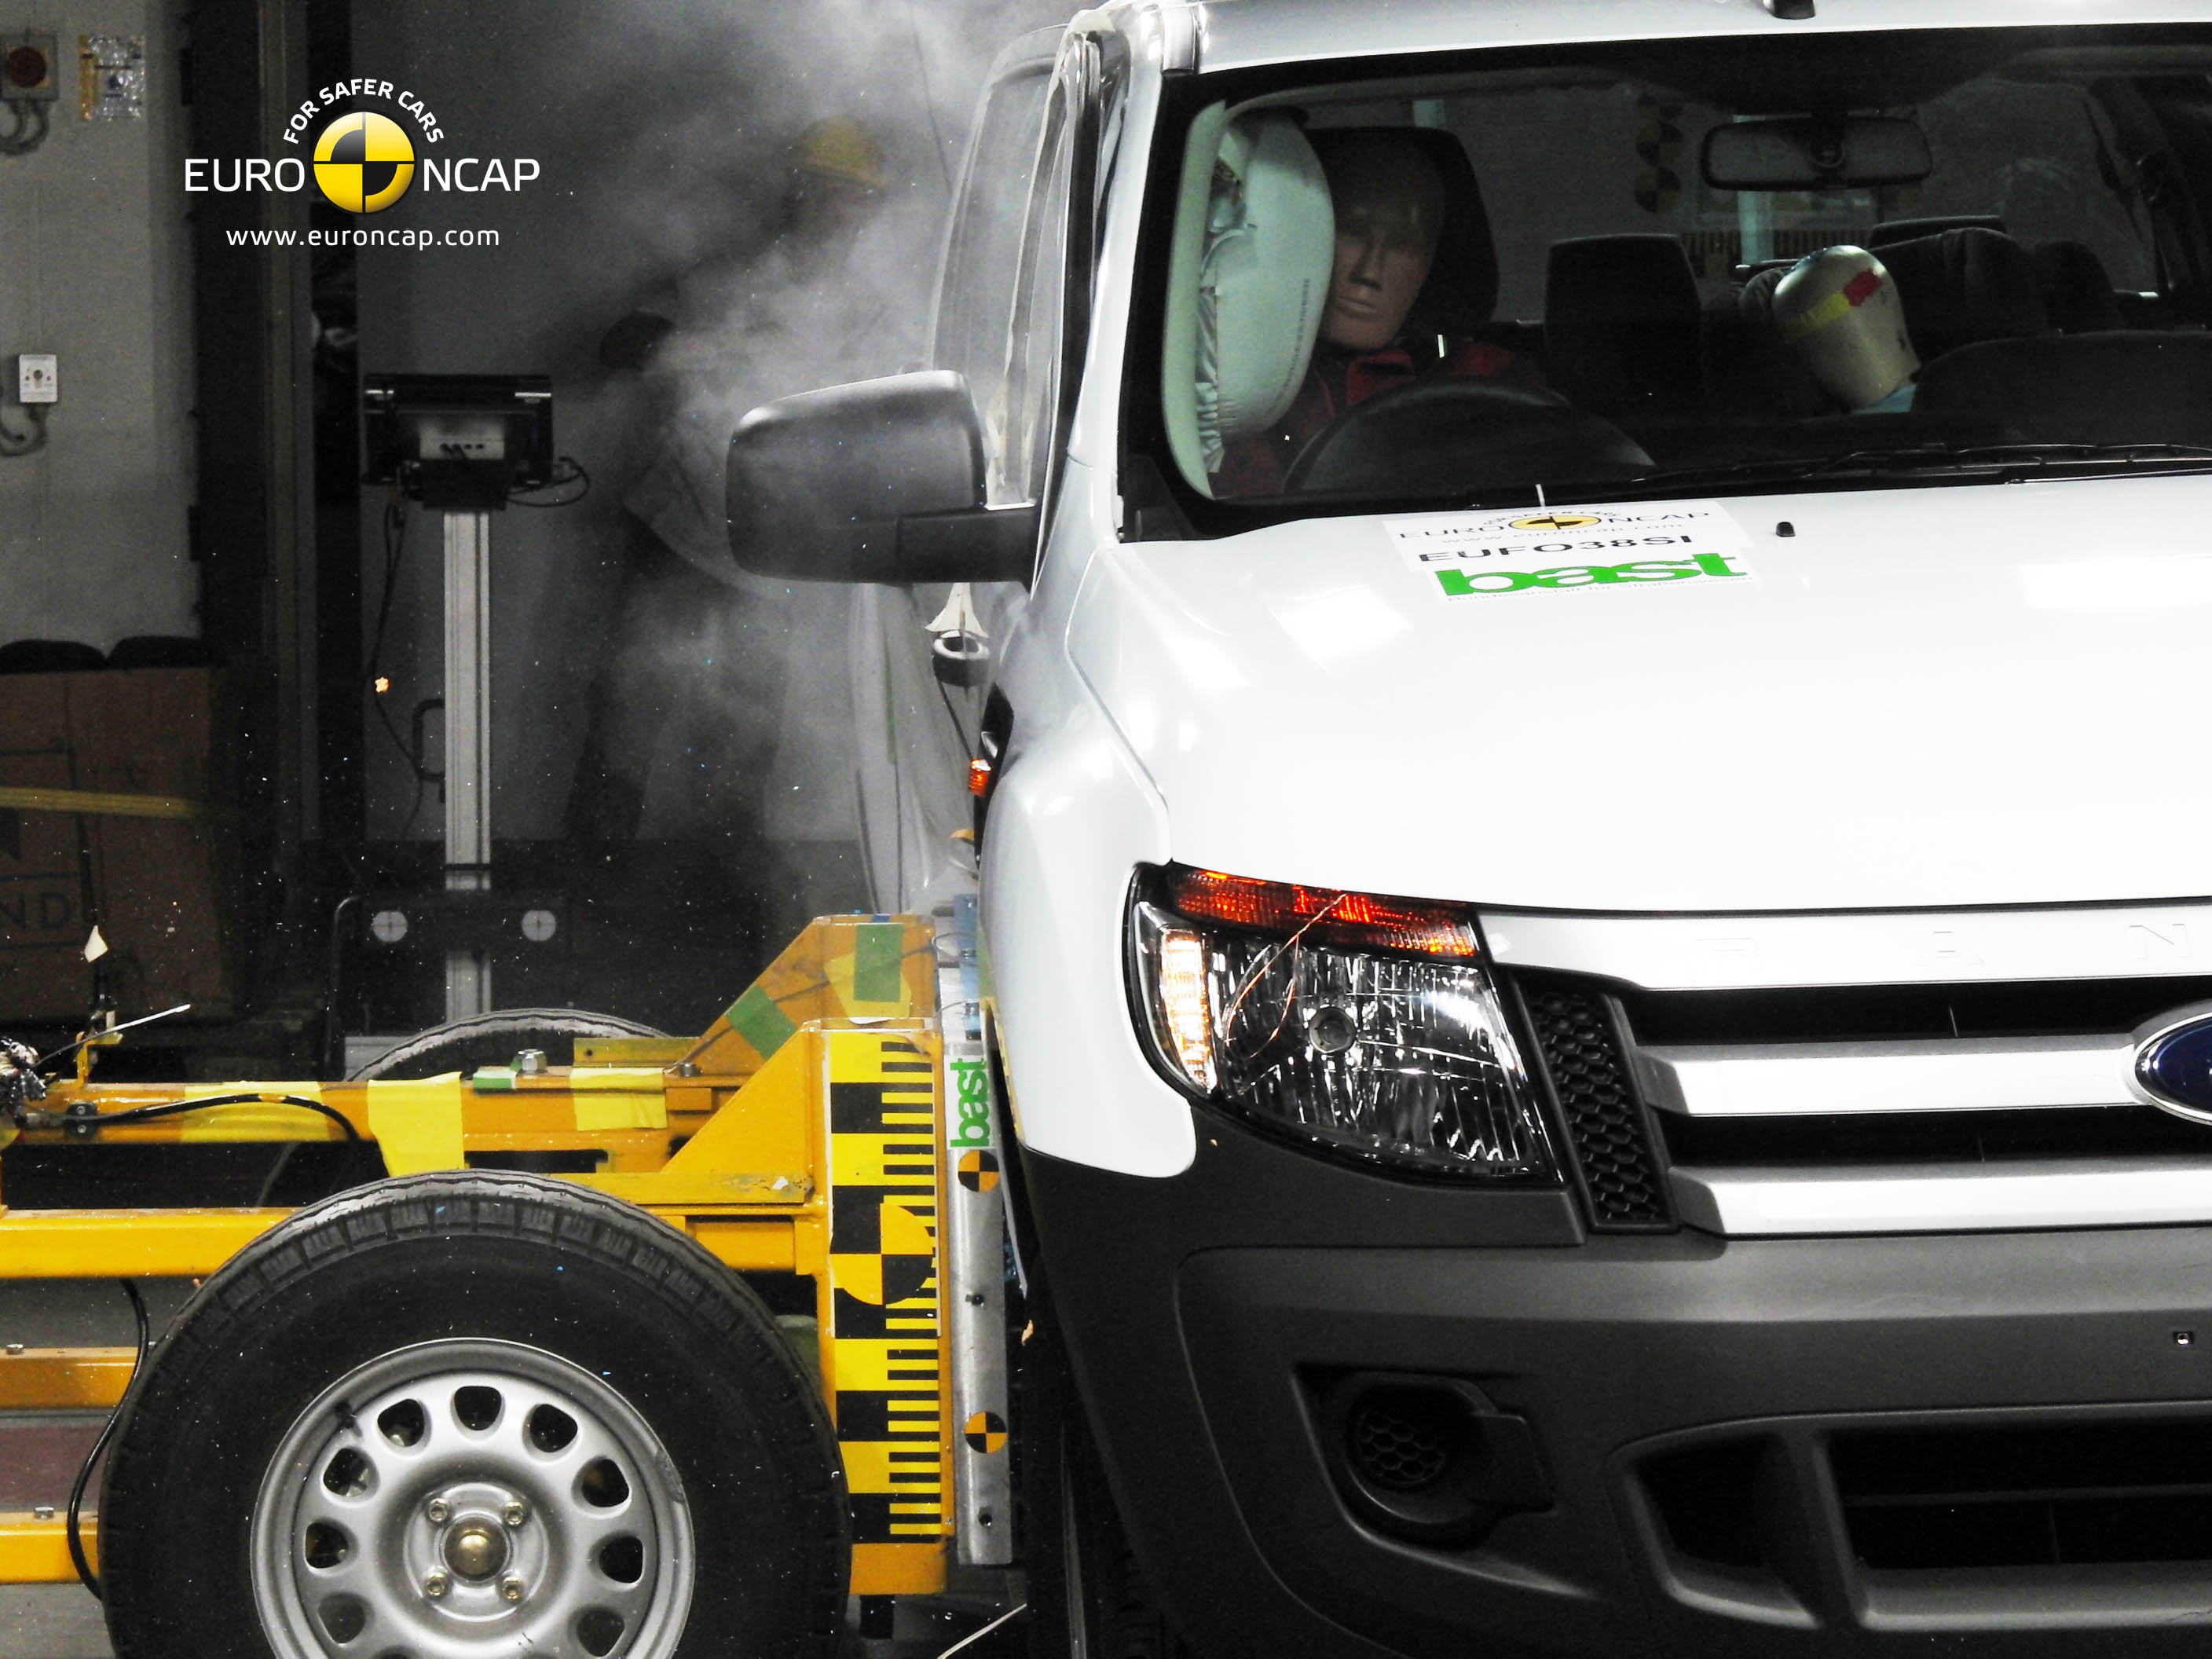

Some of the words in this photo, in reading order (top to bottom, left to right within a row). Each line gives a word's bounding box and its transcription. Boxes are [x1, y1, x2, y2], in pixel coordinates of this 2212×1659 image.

[1400, 526, 1505, 539] EURO
[1608, 511, 1709, 524] NCAP
[1434, 552, 1748, 596] bast
[950, 1057, 991, 1147] bast
